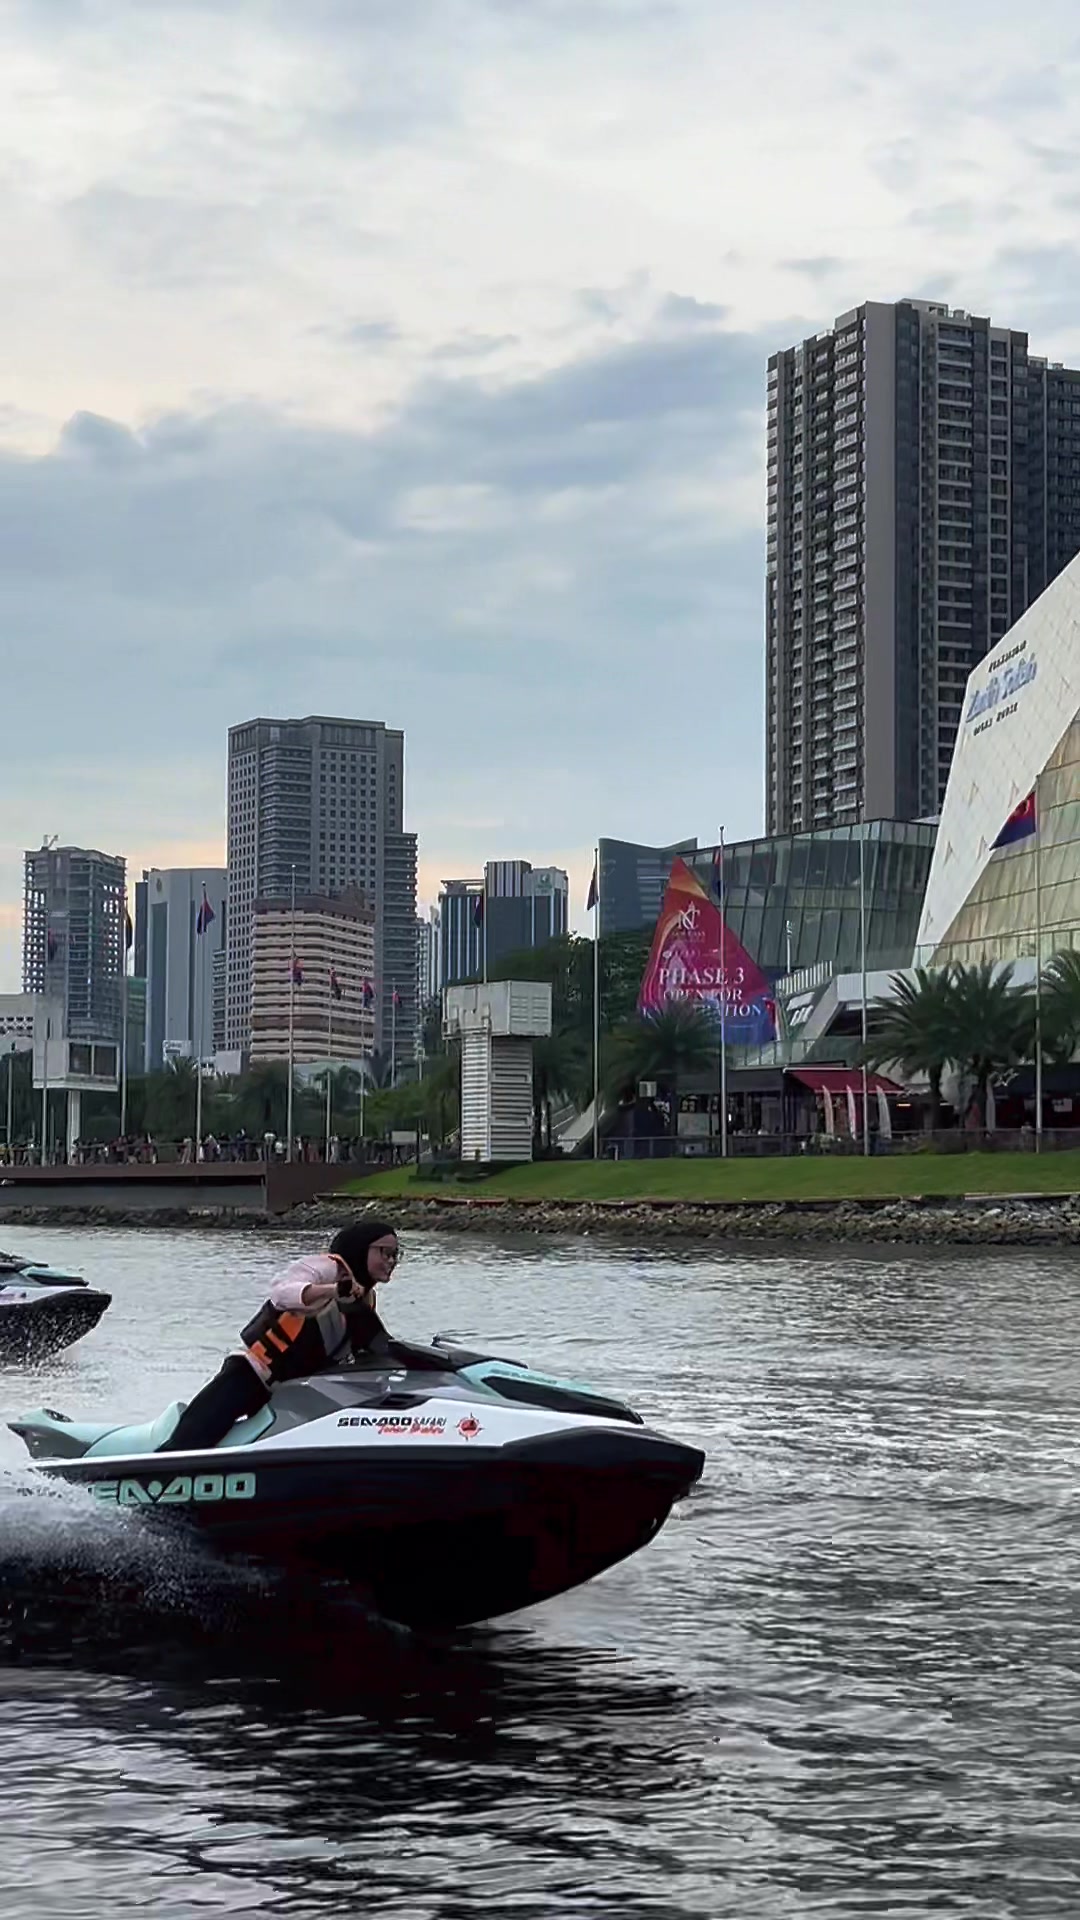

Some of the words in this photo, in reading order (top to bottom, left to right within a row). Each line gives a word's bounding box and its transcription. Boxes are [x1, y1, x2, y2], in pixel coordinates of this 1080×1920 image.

[659, 968, 728, 985] PHASE
[734, 967, 744, 984] 3
[663, 988, 705, 1001] OPEN
[412, 1416, 446, 1427] SAFARI
